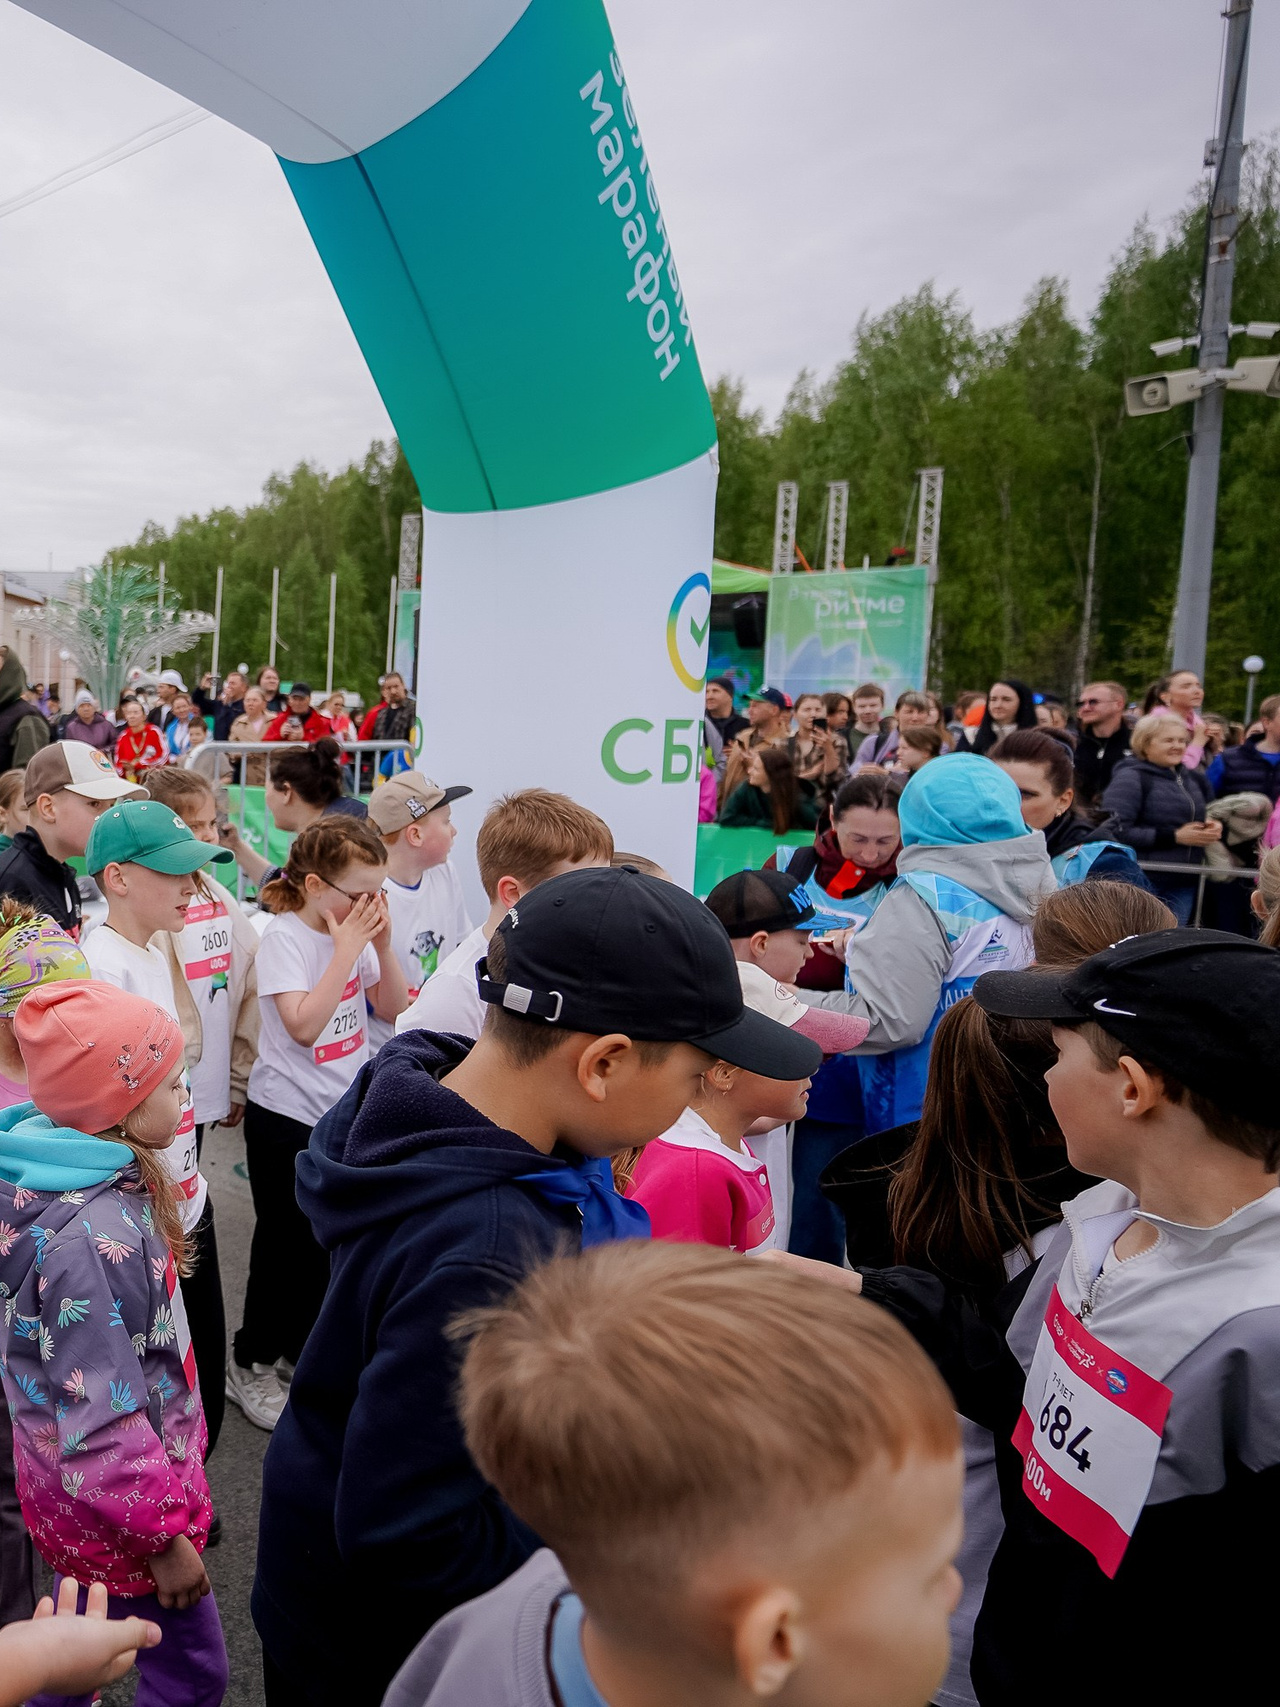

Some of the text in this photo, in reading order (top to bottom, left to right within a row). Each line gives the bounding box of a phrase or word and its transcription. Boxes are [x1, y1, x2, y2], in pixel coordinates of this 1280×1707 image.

[579, 69, 681, 382] марафон
[815, 594, 906, 624] ритме
[201, 930, 228, 952] 2600
[333, 1009, 358, 1036] 2725
[1039, 1392, 1094, 1474] 684
[98, 1448, 120, 1467] TR
[130, 1454, 149, 1474] TR
[83, 1486, 106, 1503] TR
[121, 1489, 145, 1509] TR
[156, 1493, 176, 1512] TR
[56, 1502, 74, 1517] TR
[81, 1529, 100, 1541] TR
[148, 1531, 172, 1546] TR
[63, 1545, 80, 1558] TR
